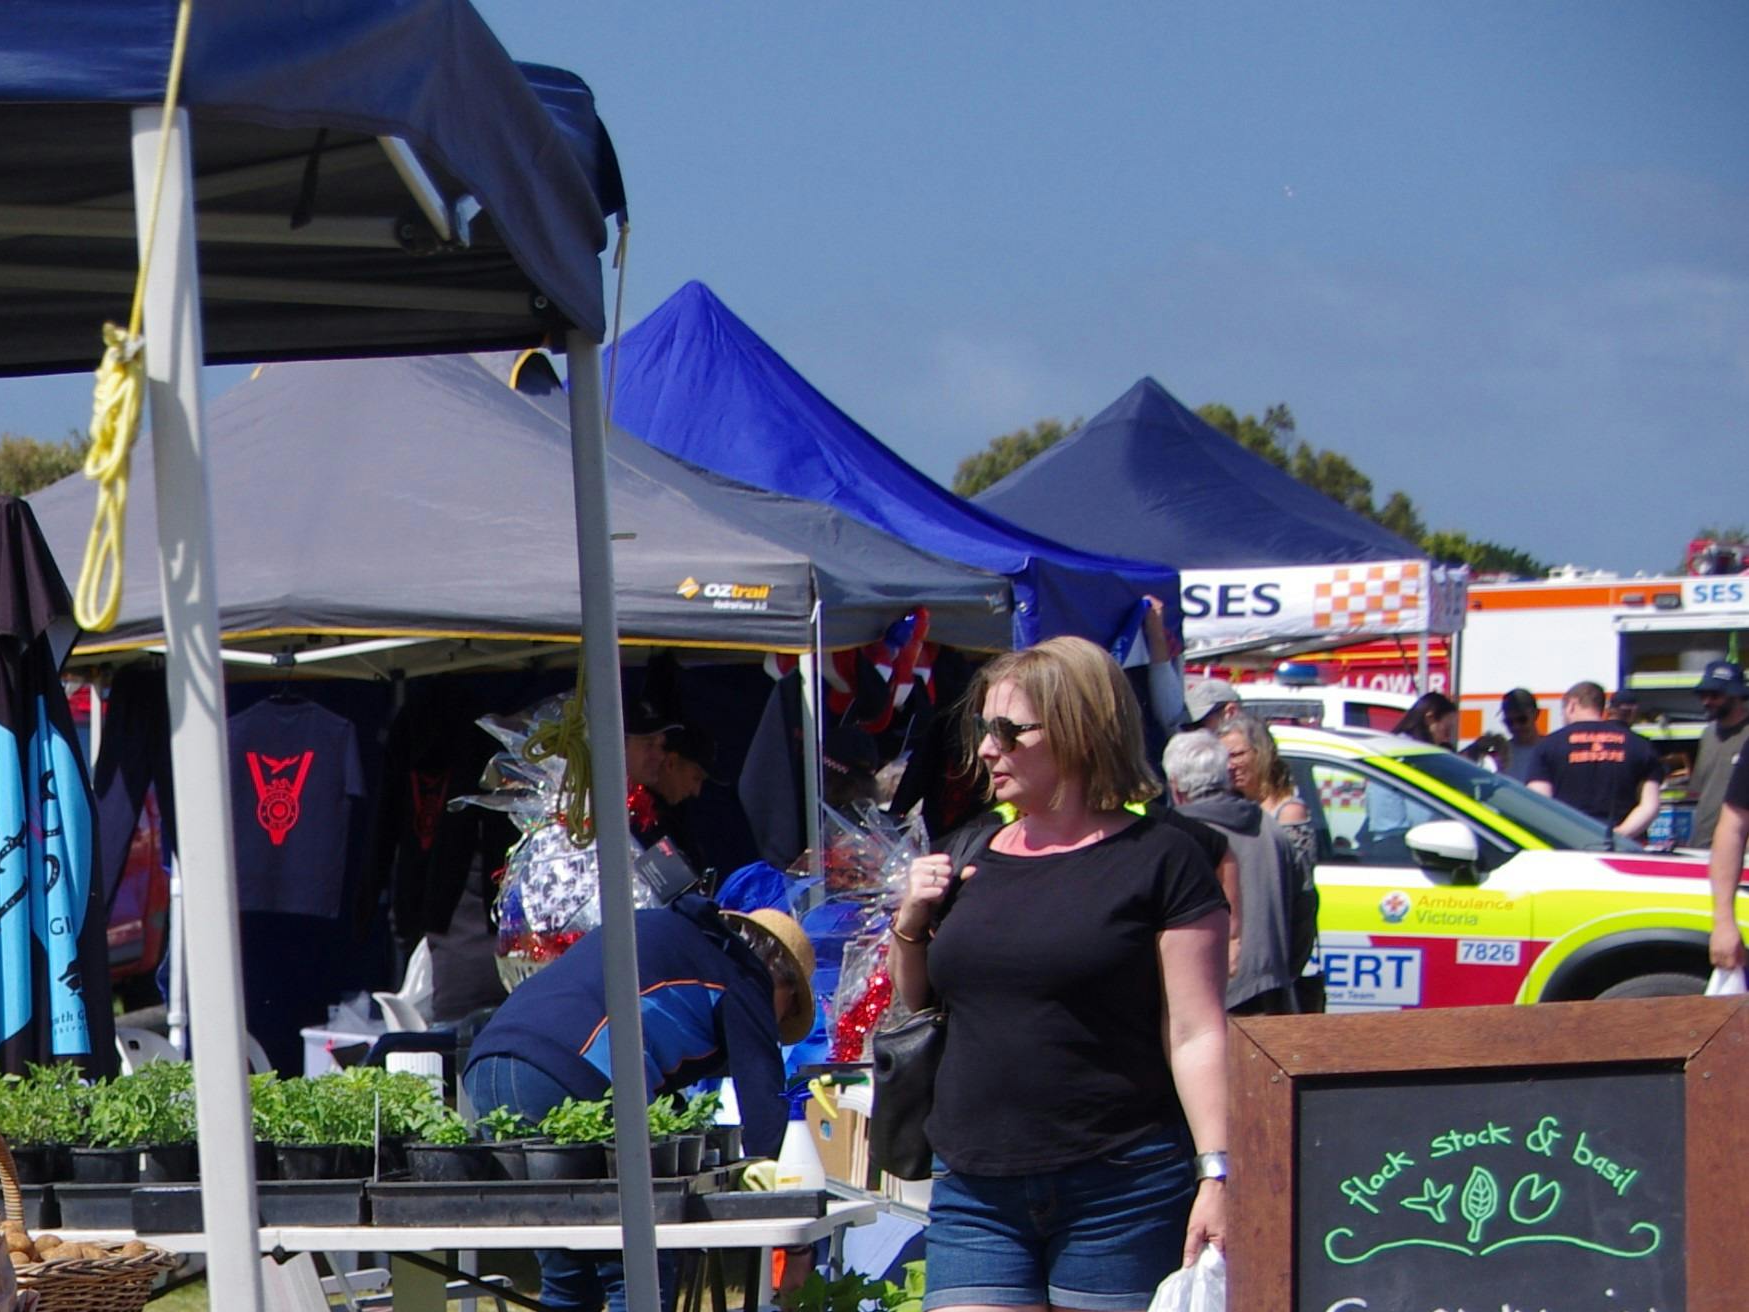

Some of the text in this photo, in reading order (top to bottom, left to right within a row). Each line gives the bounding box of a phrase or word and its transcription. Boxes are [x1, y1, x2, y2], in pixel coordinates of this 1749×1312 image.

[1181, 583, 1281, 619] SES
[1693, 583, 1743, 603] SES
[1417, 895, 1514, 911] Ambulance
[1415, 910, 1479, 926] Victoria
[1461, 943, 1515, 962] 7826
[1312, 953, 1414, 988] ERT
[1340, 1116, 1639, 1215] flock stock & basil
